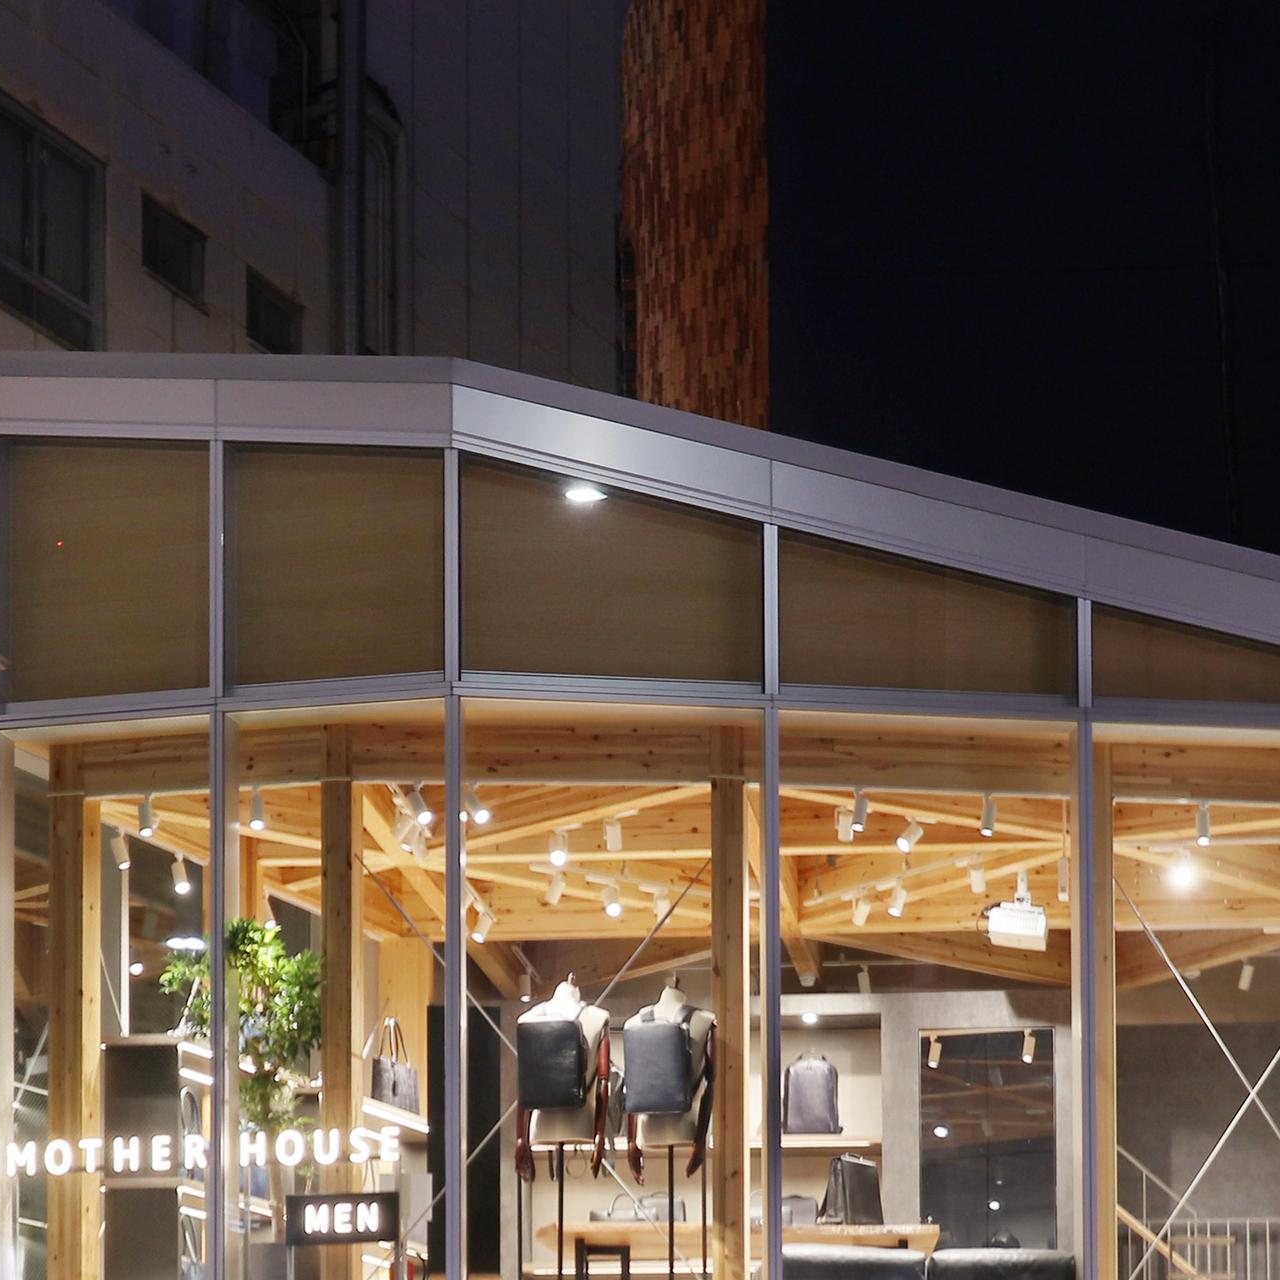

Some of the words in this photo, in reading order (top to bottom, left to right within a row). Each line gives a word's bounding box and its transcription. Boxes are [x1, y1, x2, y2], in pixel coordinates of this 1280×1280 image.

[6, 1134, 207, 1177] MOTHER
[239, 1126, 400, 1168] HOUSE
[304, 1201, 380, 1235] MEN
